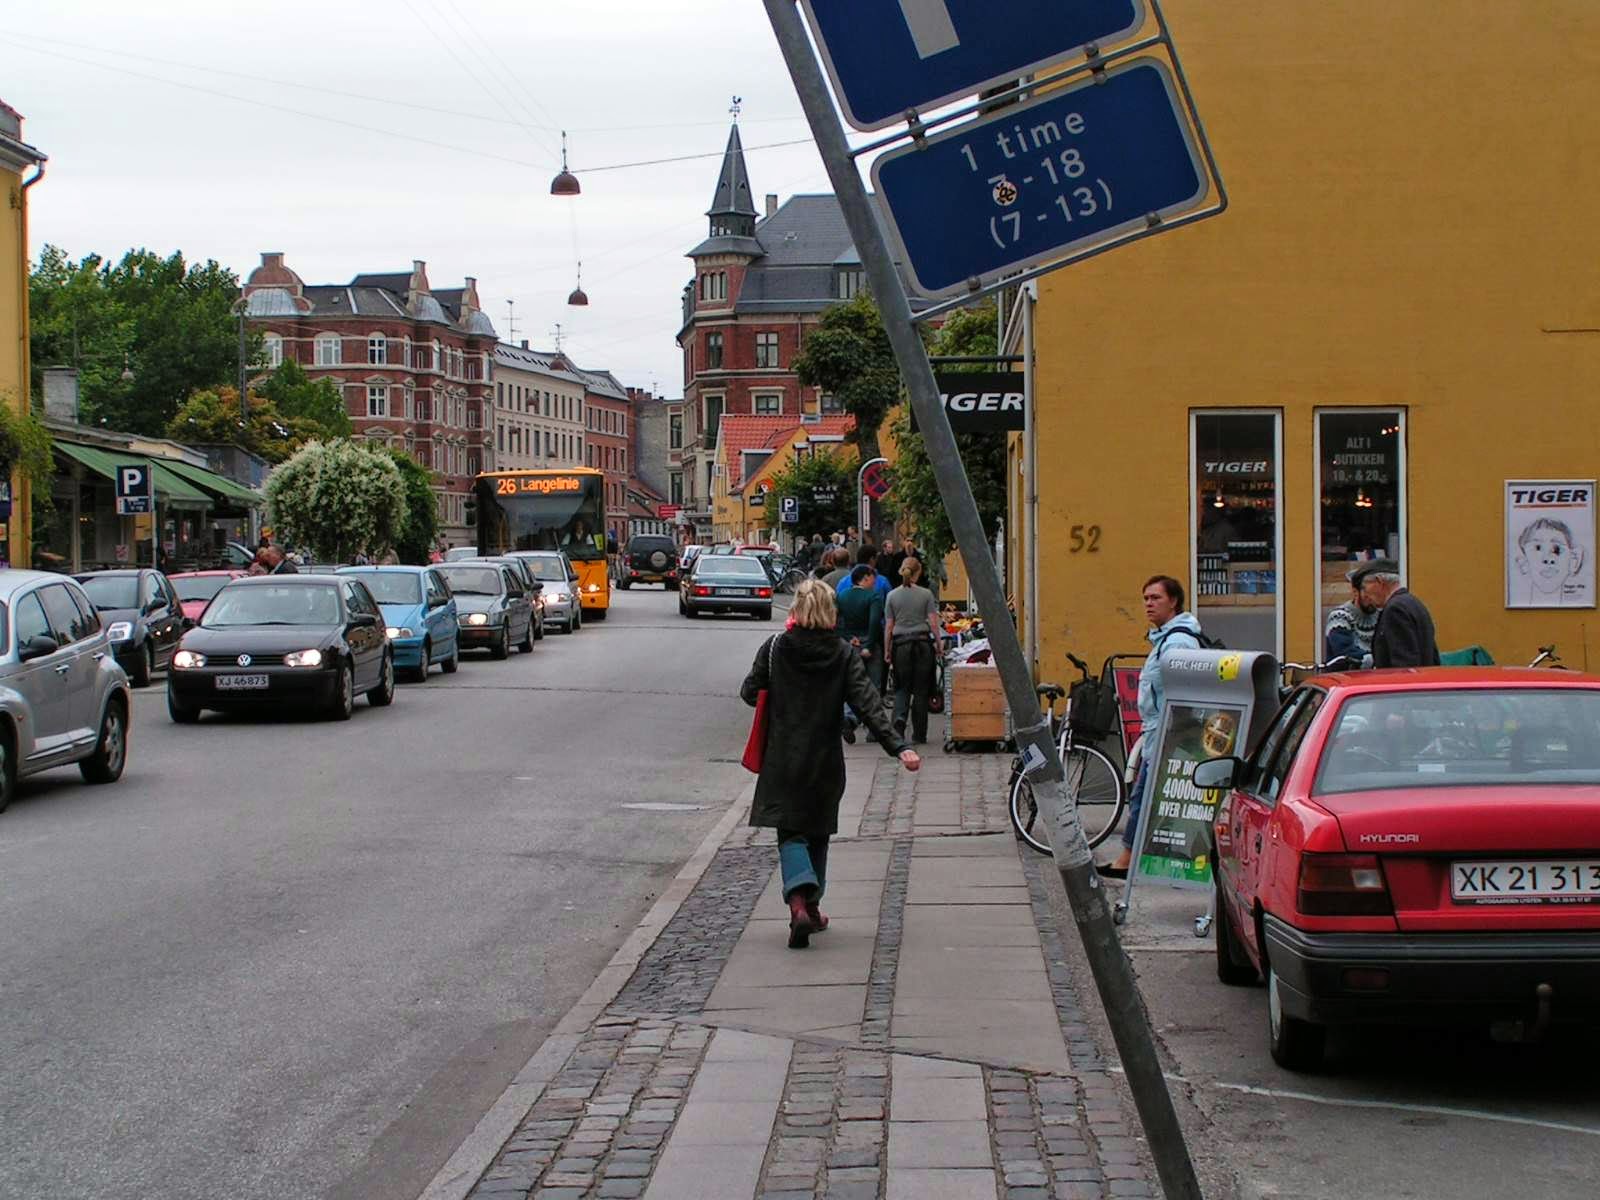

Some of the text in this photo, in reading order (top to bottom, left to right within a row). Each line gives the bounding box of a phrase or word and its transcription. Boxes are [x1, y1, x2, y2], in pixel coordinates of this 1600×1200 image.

[961, 112, 1086, 172] 1 time
[939, 392, 1025, 412] IGER
[1346, 437, 1364, 449] ALT
[1334, 453, 1385, 465] BUTIKKEN
[1205, 461, 1267, 473] TIGER
[123, 469, 142, 494] P
[497, 477, 580, 494] 26 Langelinie
[1512, 490, 1588, 503] TIGER
[784, 498, 795, 512] P
[1070, 525, 1101, 552] 52
[1169, 659, 1189, 671] SPIL
[1167, 759, 1182, 774] TIP
[1158, 800, 1215, 822] HVER LØRDAG
[1360, 834, 1419, 843] HYUNDAI
[1459, 866, 1600, 892] XK 21 313
